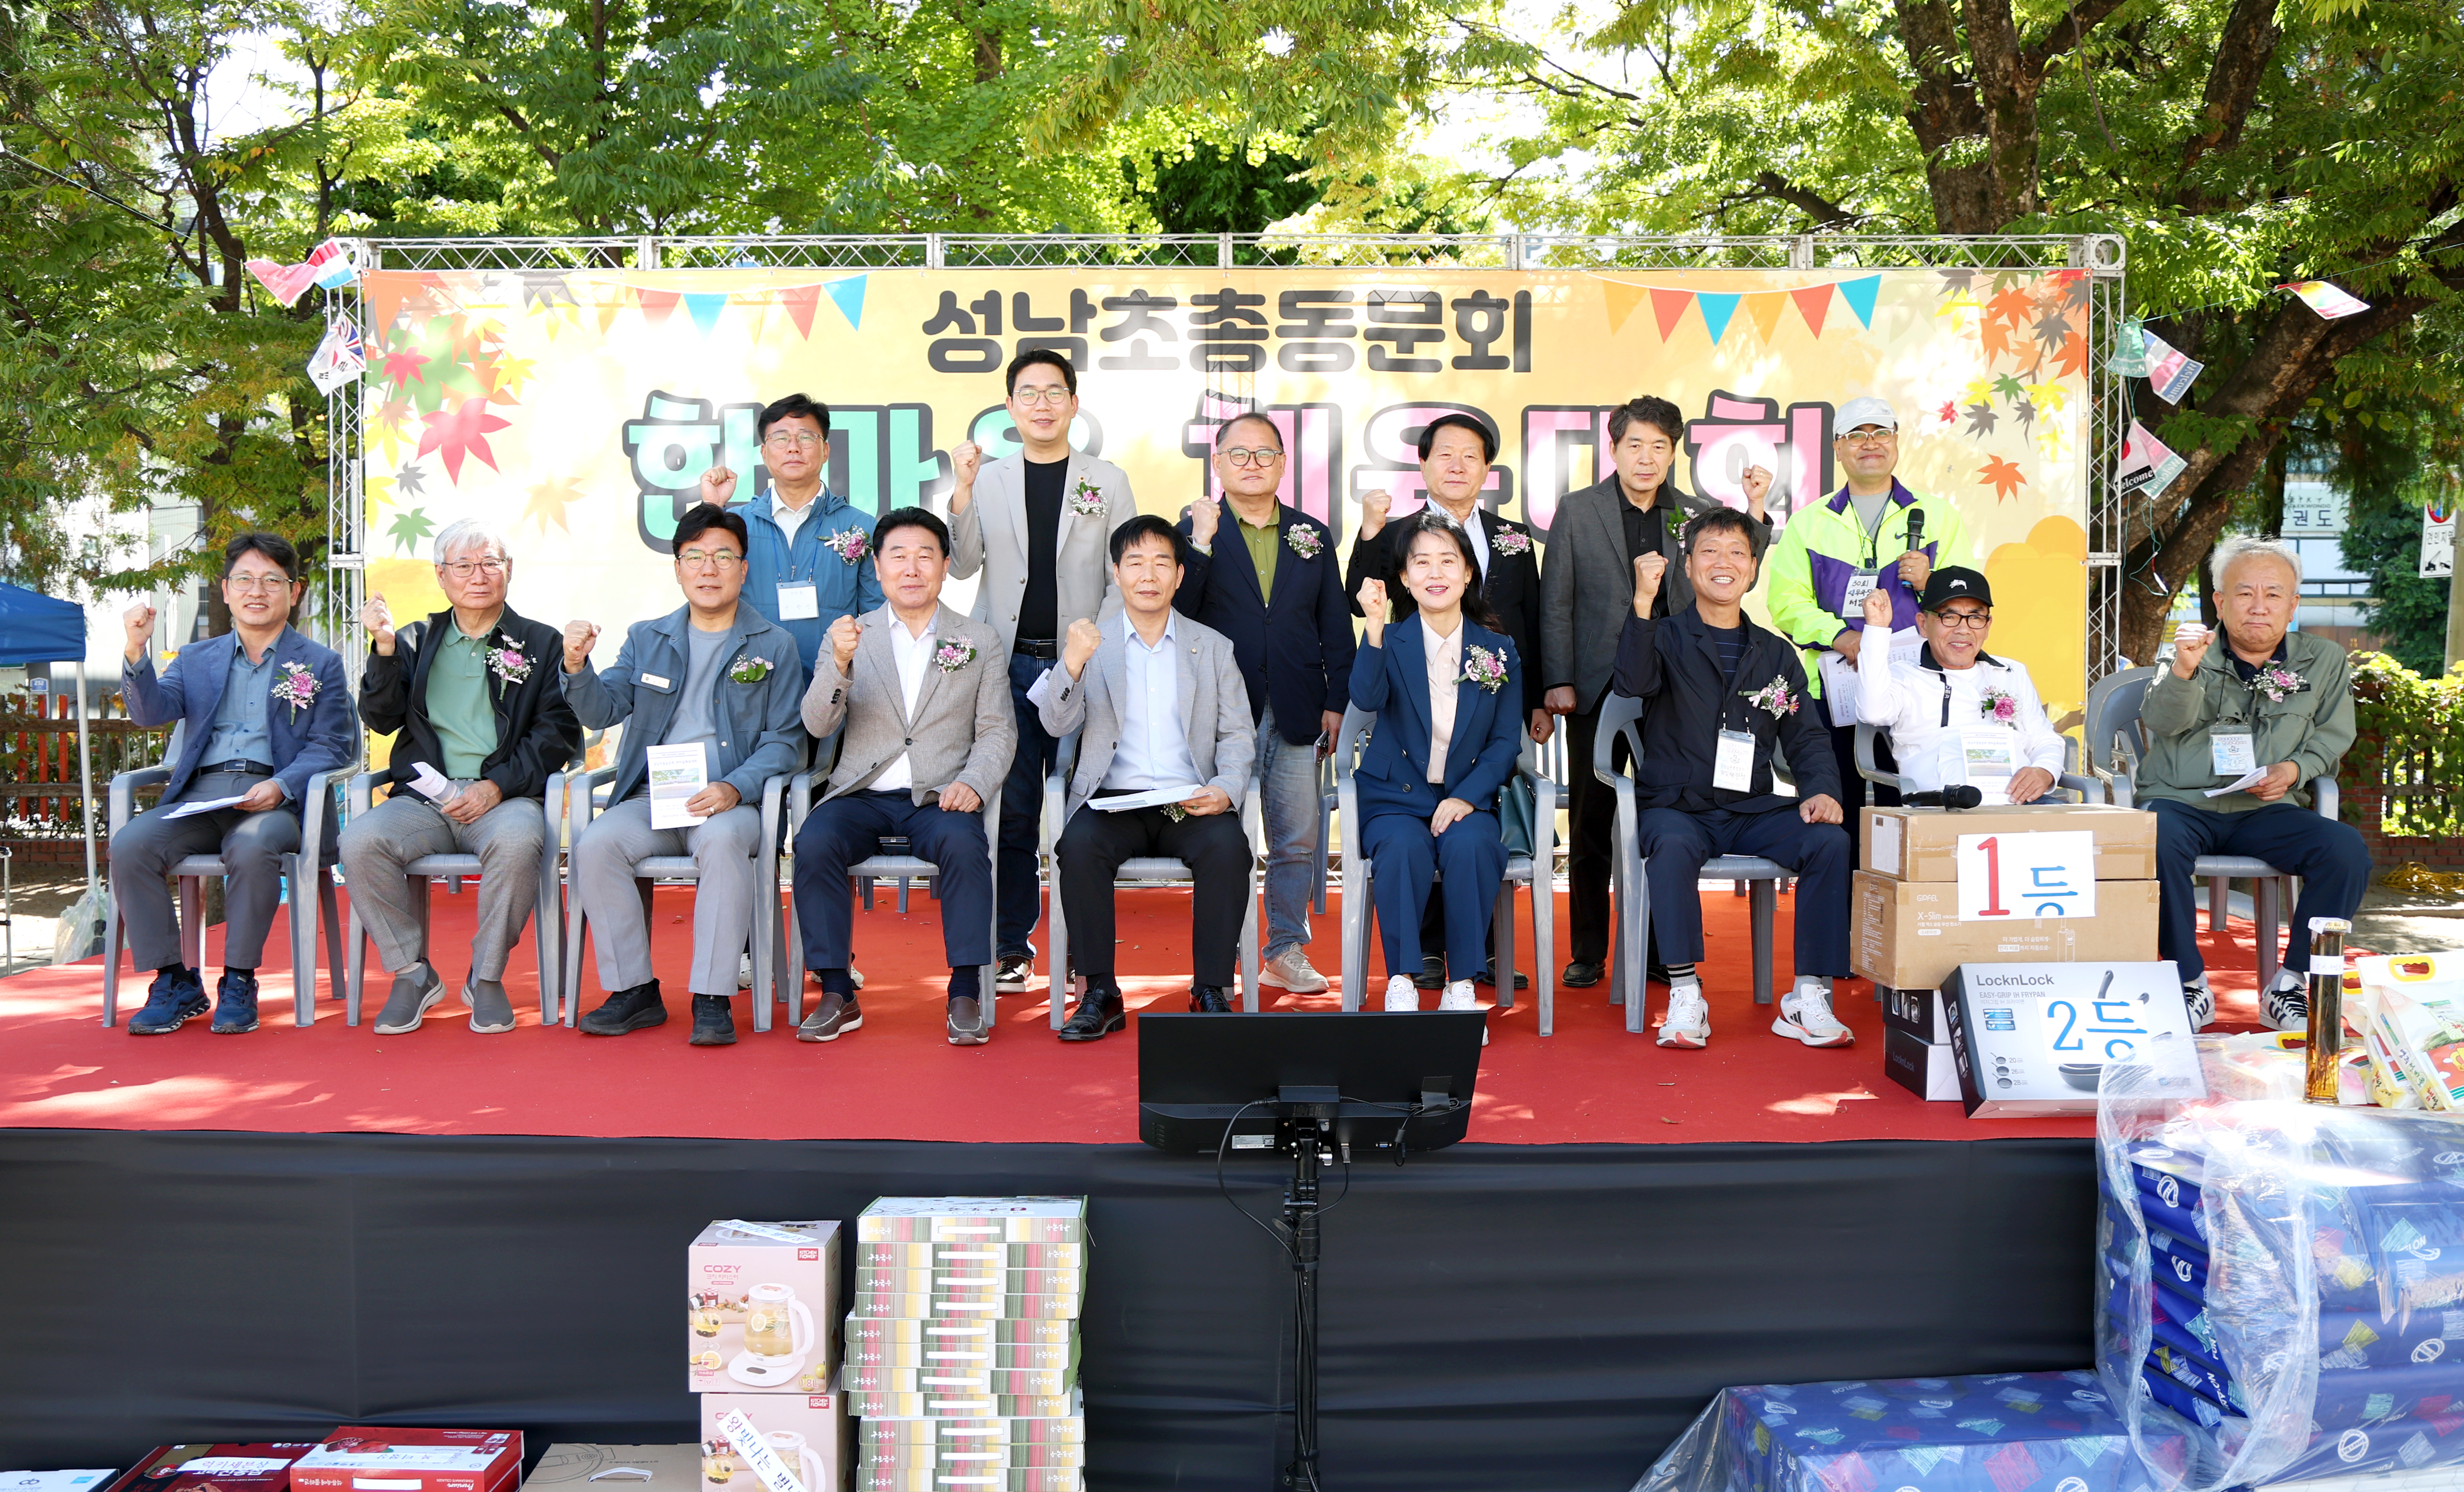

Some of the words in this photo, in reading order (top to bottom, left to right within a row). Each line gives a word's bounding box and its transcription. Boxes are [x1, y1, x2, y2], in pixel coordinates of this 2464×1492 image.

[922, 288, 1532, 373] 성남초총동문회
[1977, 836, 2079, 917] 1등
[1917, 911, 1941, 920] X-Slim
[1976, 974, 2055, 986] LocknLock
[2047, 1000, 2148, 1060] 2등
[1893, 1051, 1915, 1073] LocknLock
[799, 1378, 818, 1388] 1.8L
[727, 1416, 771, 1471] 왕빛나는
[202, 1460, 270, 1469] 럭키세븐상
[446, 1482, 474, 1491] Premium
